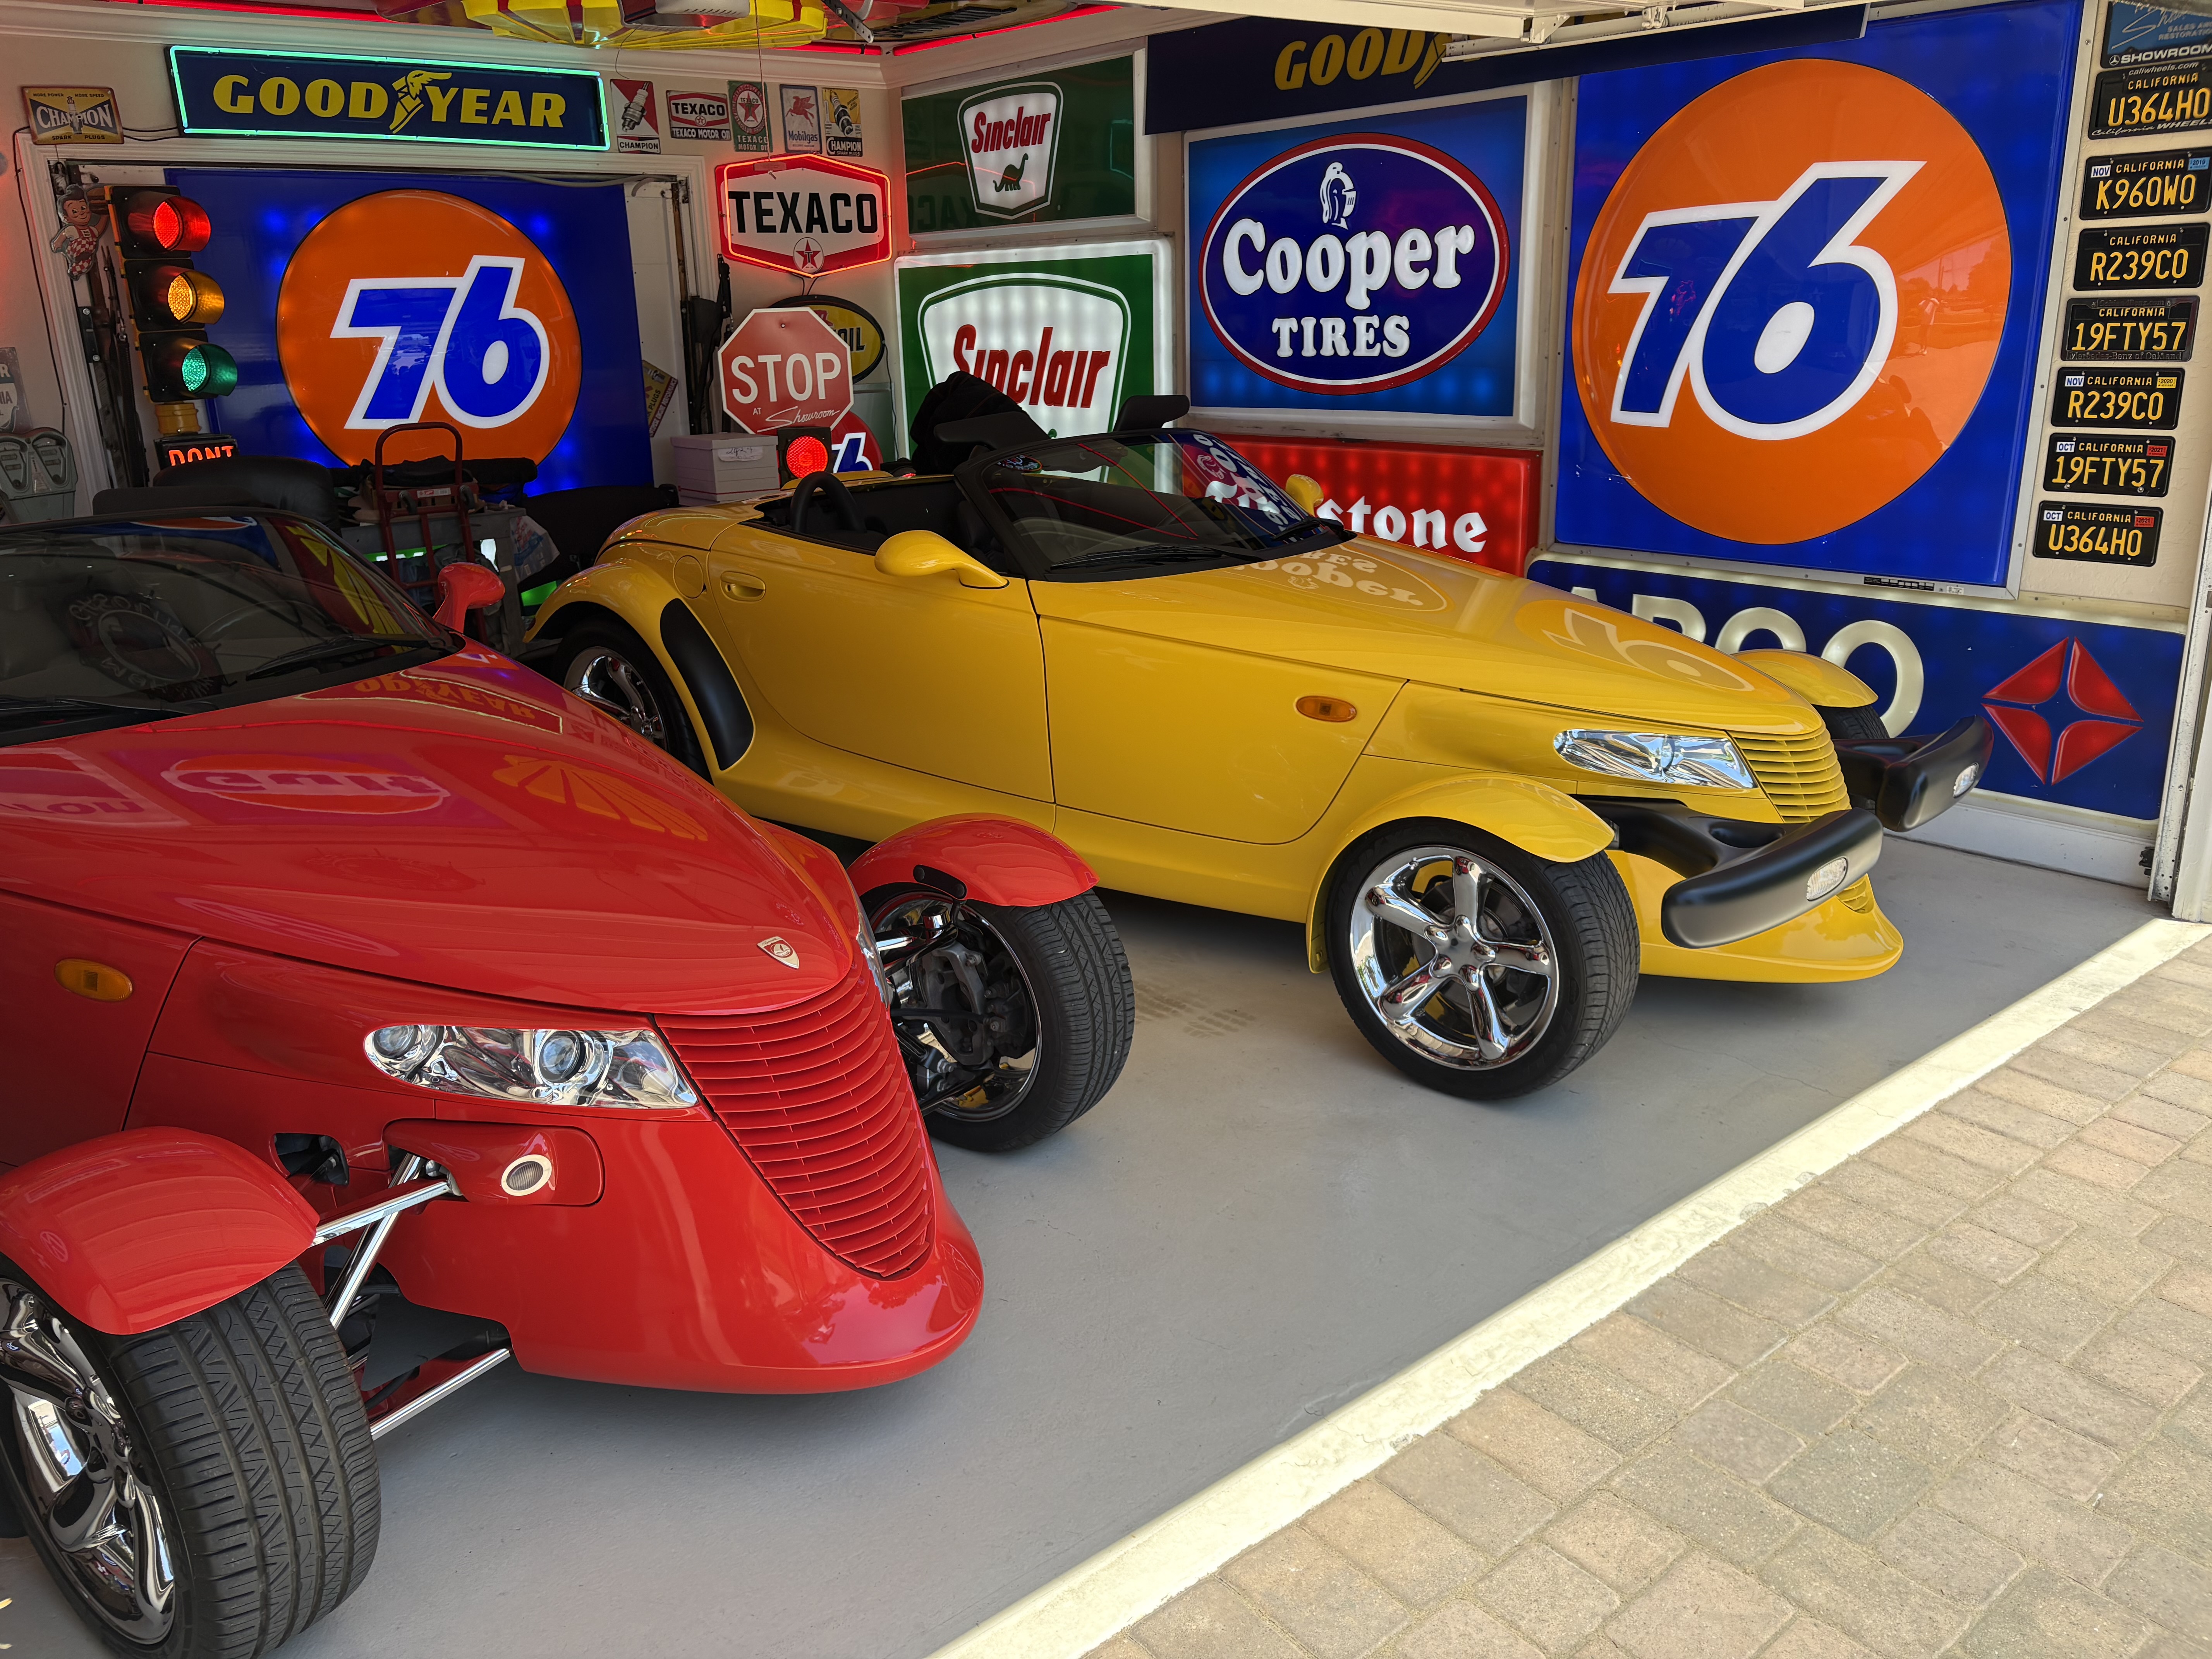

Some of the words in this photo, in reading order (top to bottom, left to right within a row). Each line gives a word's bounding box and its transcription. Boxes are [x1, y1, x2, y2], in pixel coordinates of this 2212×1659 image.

[2128, 72, 2199, 90] CALIFORNIA
[36, 104, 113, 128] CHAMPION
[672, 102, 725, 116] TEXACO
[672, 128, 696, 138] TEXACO
[698, 129, 719, 139] MOTOR
[788, 130, 818, 143] Mobilgas
[971, 106, 1051, 153] Sinclair
[2092, 126, 2155, 136] California
[620, 141, 658, 149] CHAMPION
[827, 137, 861, 155] CHAMPION
[2093, 167, 2110, 177] NOV
[2116, 159, 2185, 173] CALIFORNIA
[728, 191, 878, 233] TEXACO
[2109, 234, 2176, 246] CALIFORNIA
[1223, 218, 1475, 310] Cooper
[1607, 160, 1927, 441] 76
[2099, 307, 2165, 317] CALIFORNIA
[329, 254, 550, 429] 76
[1272, 315, 1410, 357] TIRES
[2071, 322, 2186, 351] 19FTY57
[731, 352, 841, 404] STOP
[2087, 376, 2152, 385] CALIFORNIA
[648, 389, 661, 410] PLUGS
[757, 405, 840, 433] Showroom
[2079, 442, 2143, 453] CALIFORNIA
[2052, 456, 2164, 488] 19FTY57
[2067, 511, 2131, 523] CALIFORNIA
